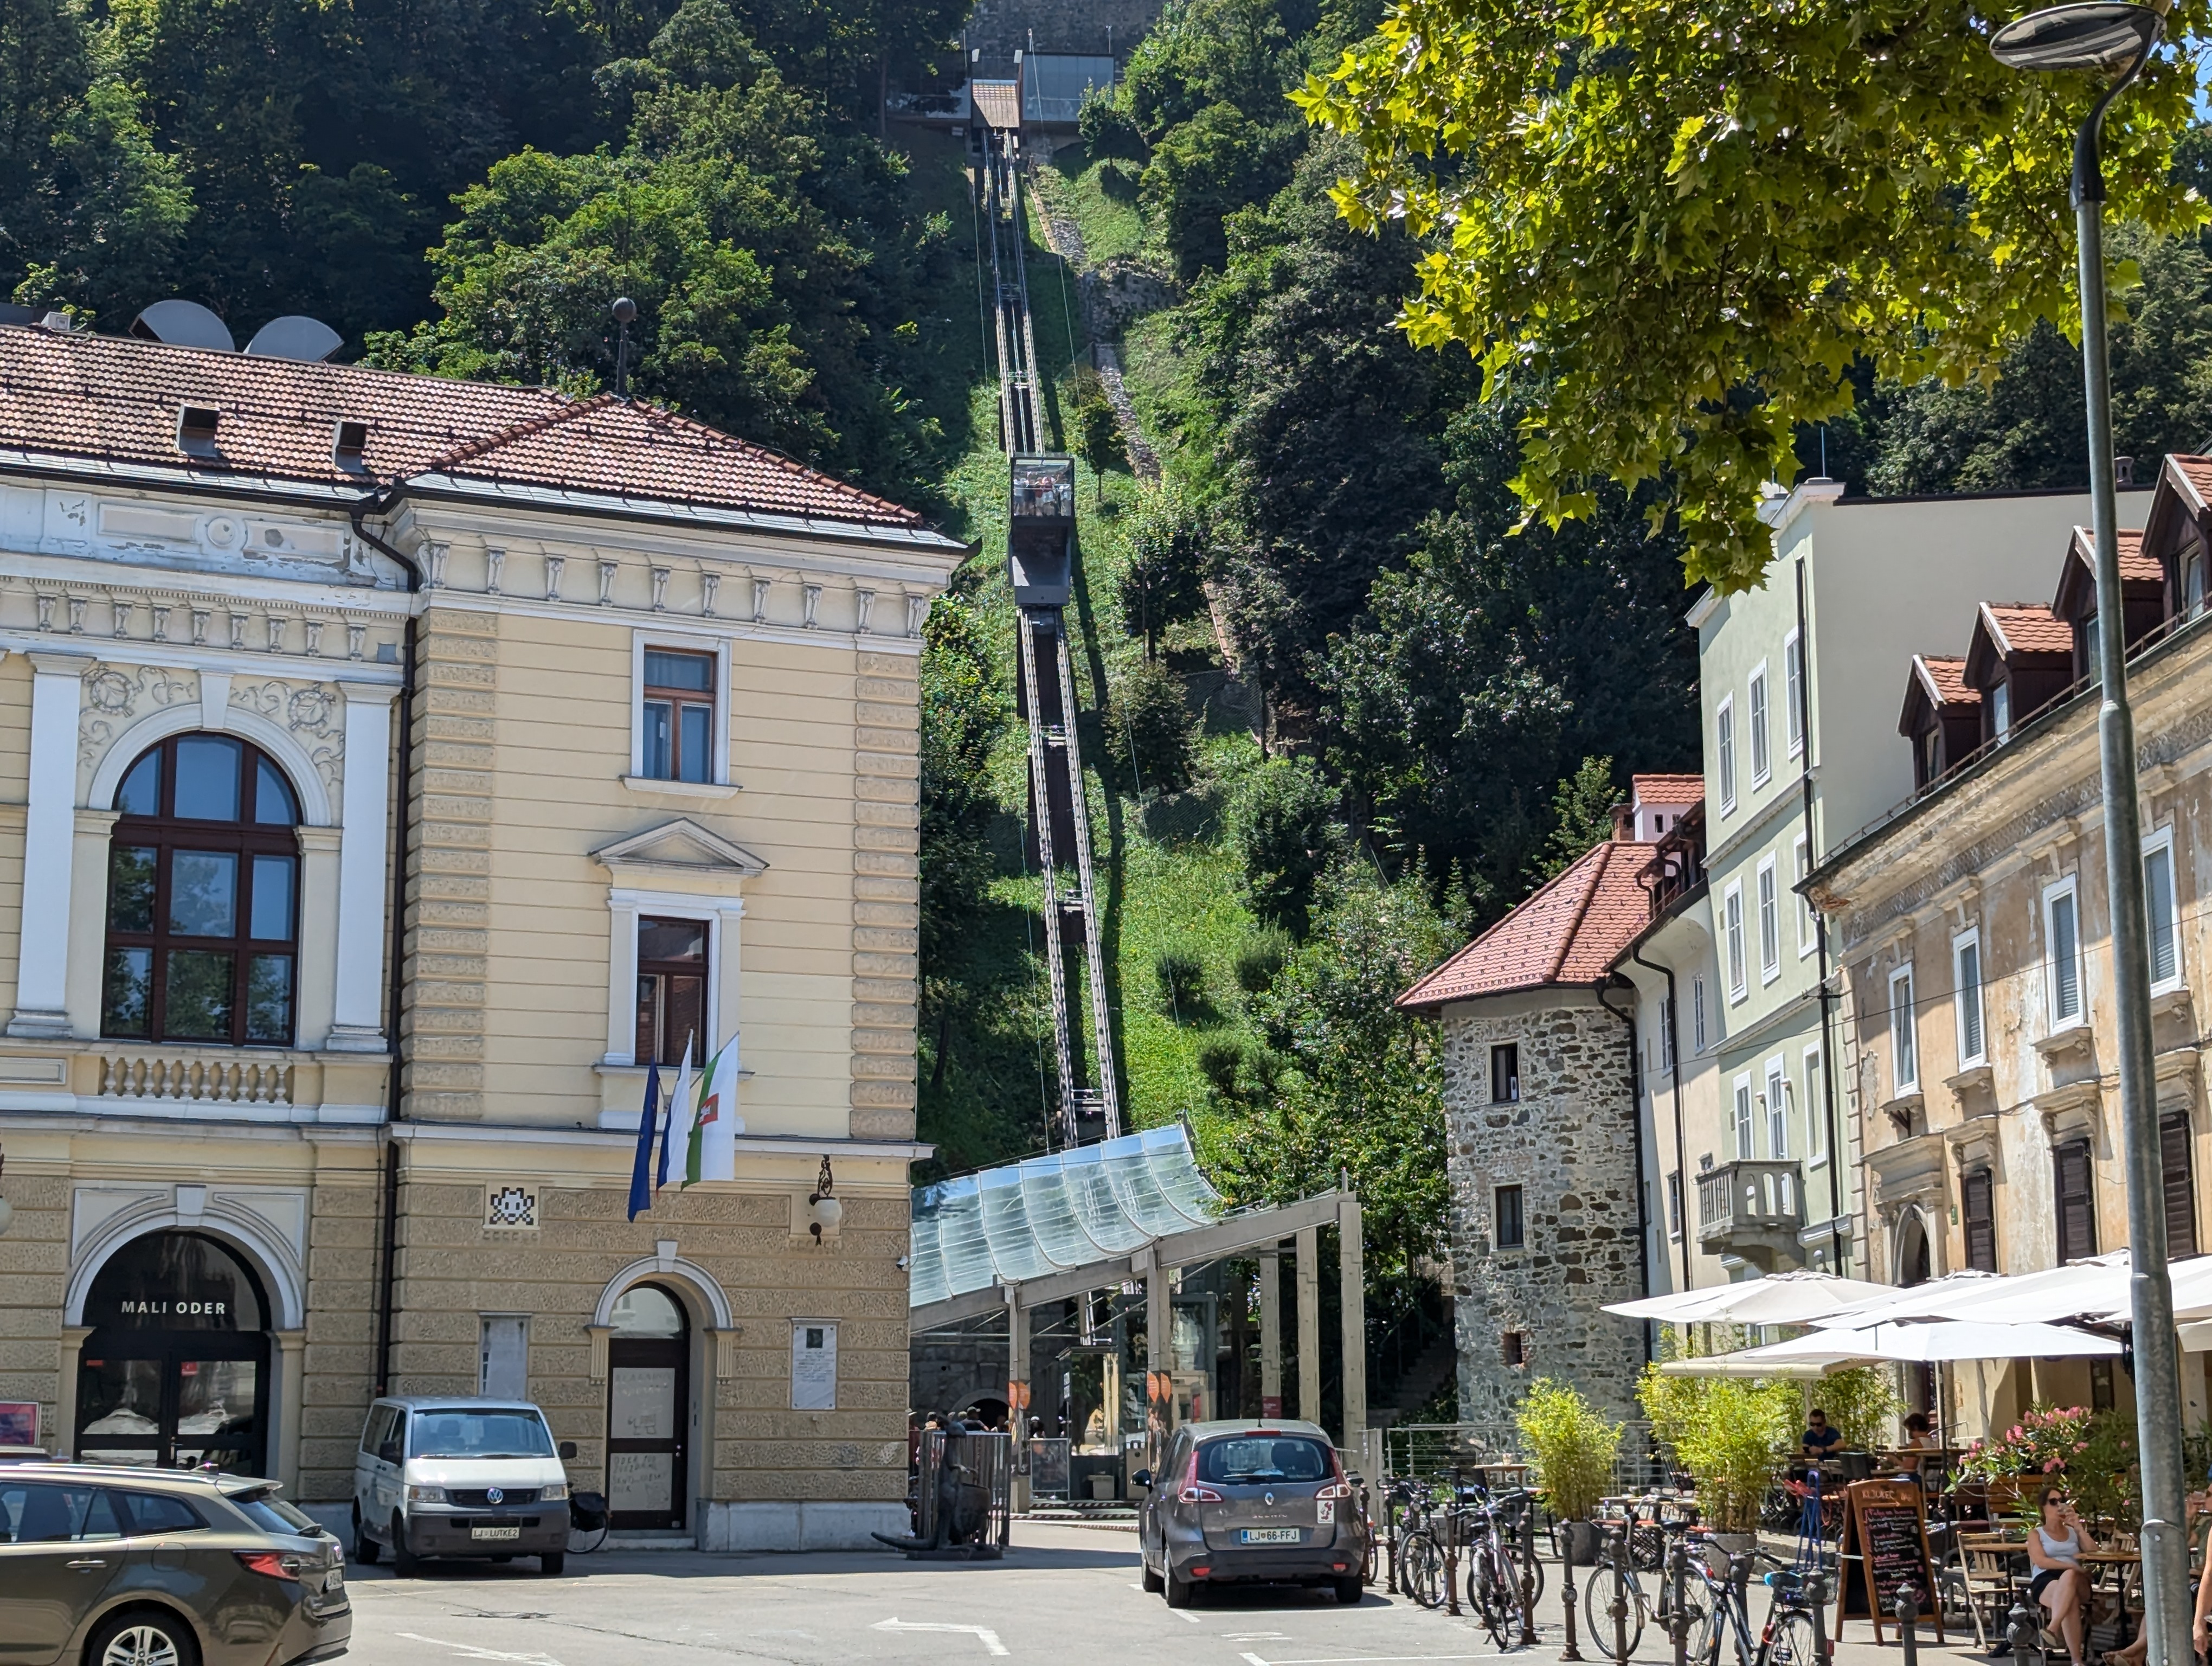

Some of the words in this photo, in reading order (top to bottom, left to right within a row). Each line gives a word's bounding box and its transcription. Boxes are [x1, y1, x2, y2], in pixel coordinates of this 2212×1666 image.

[121, 1301, 167, 1313] MALI
[176, 1302, 226, 1314] ODER
[474, 1529, 484, 1537] LJ
[1249, 1531, 1261, 1541] LJ
[1266, 1530, 1297, 1540] 66-FFJ
